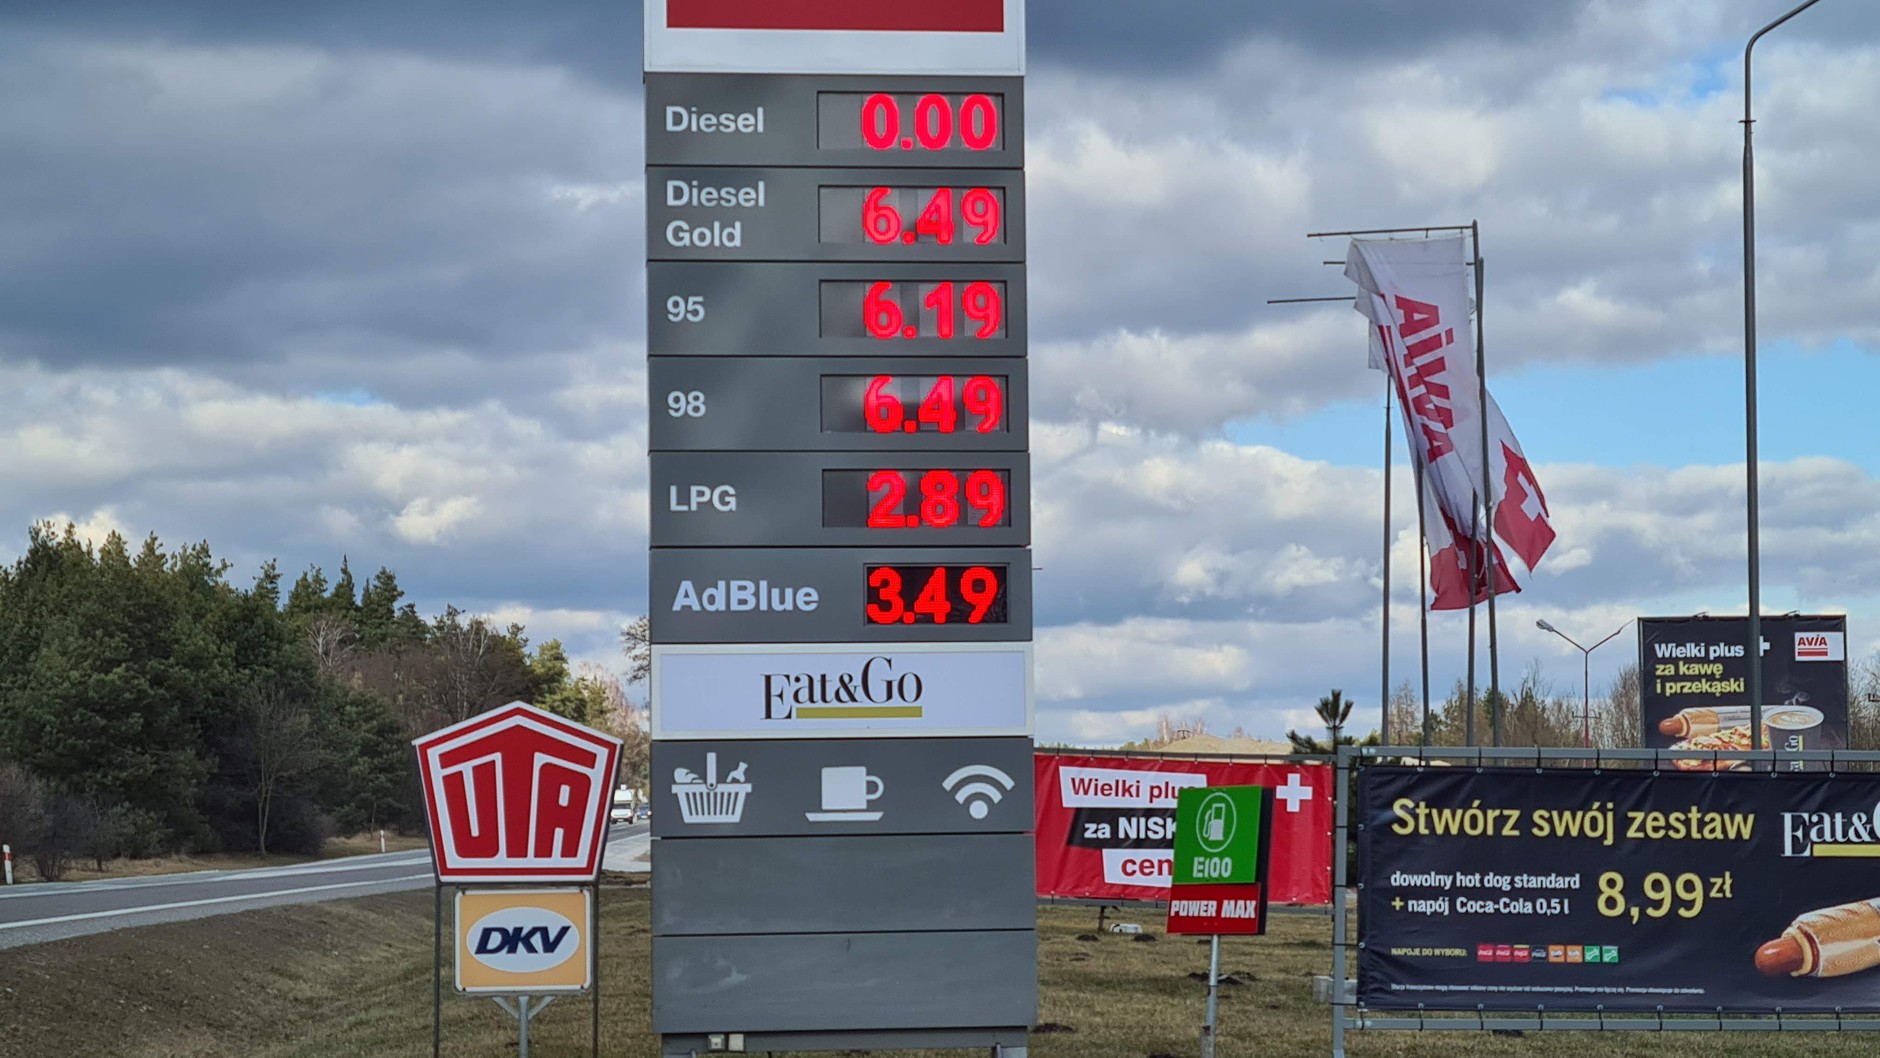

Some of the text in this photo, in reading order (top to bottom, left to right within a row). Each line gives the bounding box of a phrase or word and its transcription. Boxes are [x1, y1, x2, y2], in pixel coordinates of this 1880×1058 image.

[665, 106, 764, 133] Diesel
[861, 93, 997, 150] 0.00
[666, 180, 765, 207] Diesel
[862, 187, 1000, 245] 6.49
[666, 221, 742, 248] Gold
[667, 296, 705, 322] 95
[863, 281, 1001, 339] 6.19
[667, 391, 706, 417] 98
[864, 375, 1002, 433] 6.49
[669, 485, 737, 512] LPG
[866, 470, 1005, 528] 2.89
[671, 580, 819, 612] AdBlue
[866, 566, 998, 624] 3.49
[1654, 642, 1745, 660] Wielki plus
[1655, 661, 1723, 679] za kawę
[760, 656, 923, 720] Eat&Go
[1656, 678, 1745, 697] i przekąski
[438, 724, 597, 858] UTA
[1071, 777, 1196, 804] Wielki plu
[1084, 823, 1111, 839] za
[1391, 798, 1755, 846] Stwórz swój zestaw
[1780, 801, 1880, 857] Eat&
[1121, 858, 1173, 876] cen
[1193, 857, 1232, 878] E100
[1390, 872, 1580, 891] dowolny hot dog standard
[1170, 899, 1257, 918] POWER MAX
[1407, 897, 1450, 915] napój
[1456, 898, 1533, 915] Coca-Cola
[1536, 899, 1560, 917] 0,5
[1596, 871, 1733, 925] 8,99 zł
[475, 925, 571, 955] DKV
